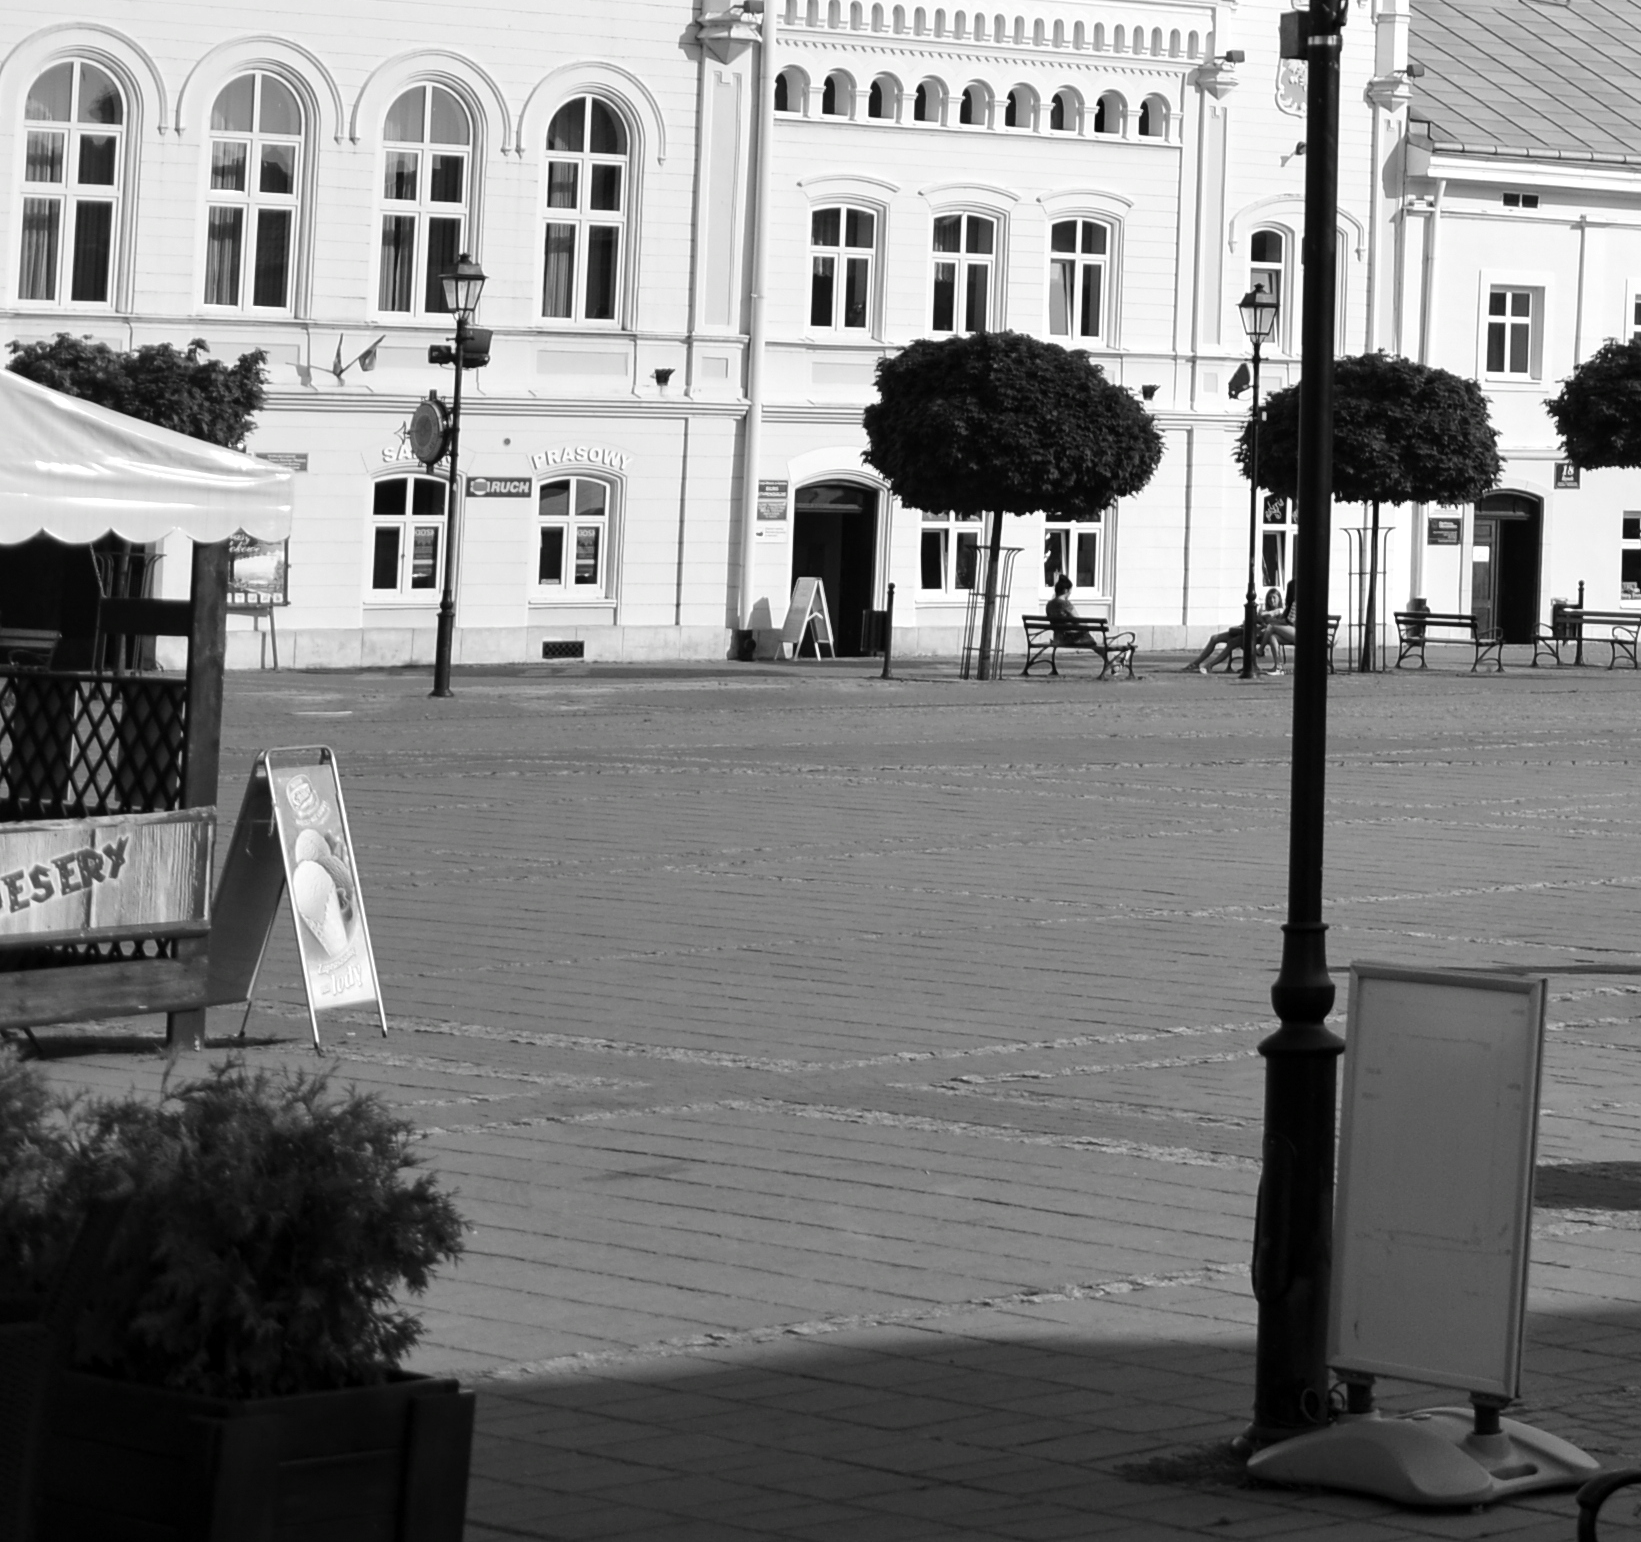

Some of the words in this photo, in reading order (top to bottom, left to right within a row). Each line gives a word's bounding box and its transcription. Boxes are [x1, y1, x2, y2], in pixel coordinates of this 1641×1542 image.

[532, 446, 633, 470] PRASOWY
[1562, 465, 1575, 476] 18
[490, 481, 530, 493] RUCH
[0, 836, 129, 914] ESERY
[331, 962, 364, 997] lody
